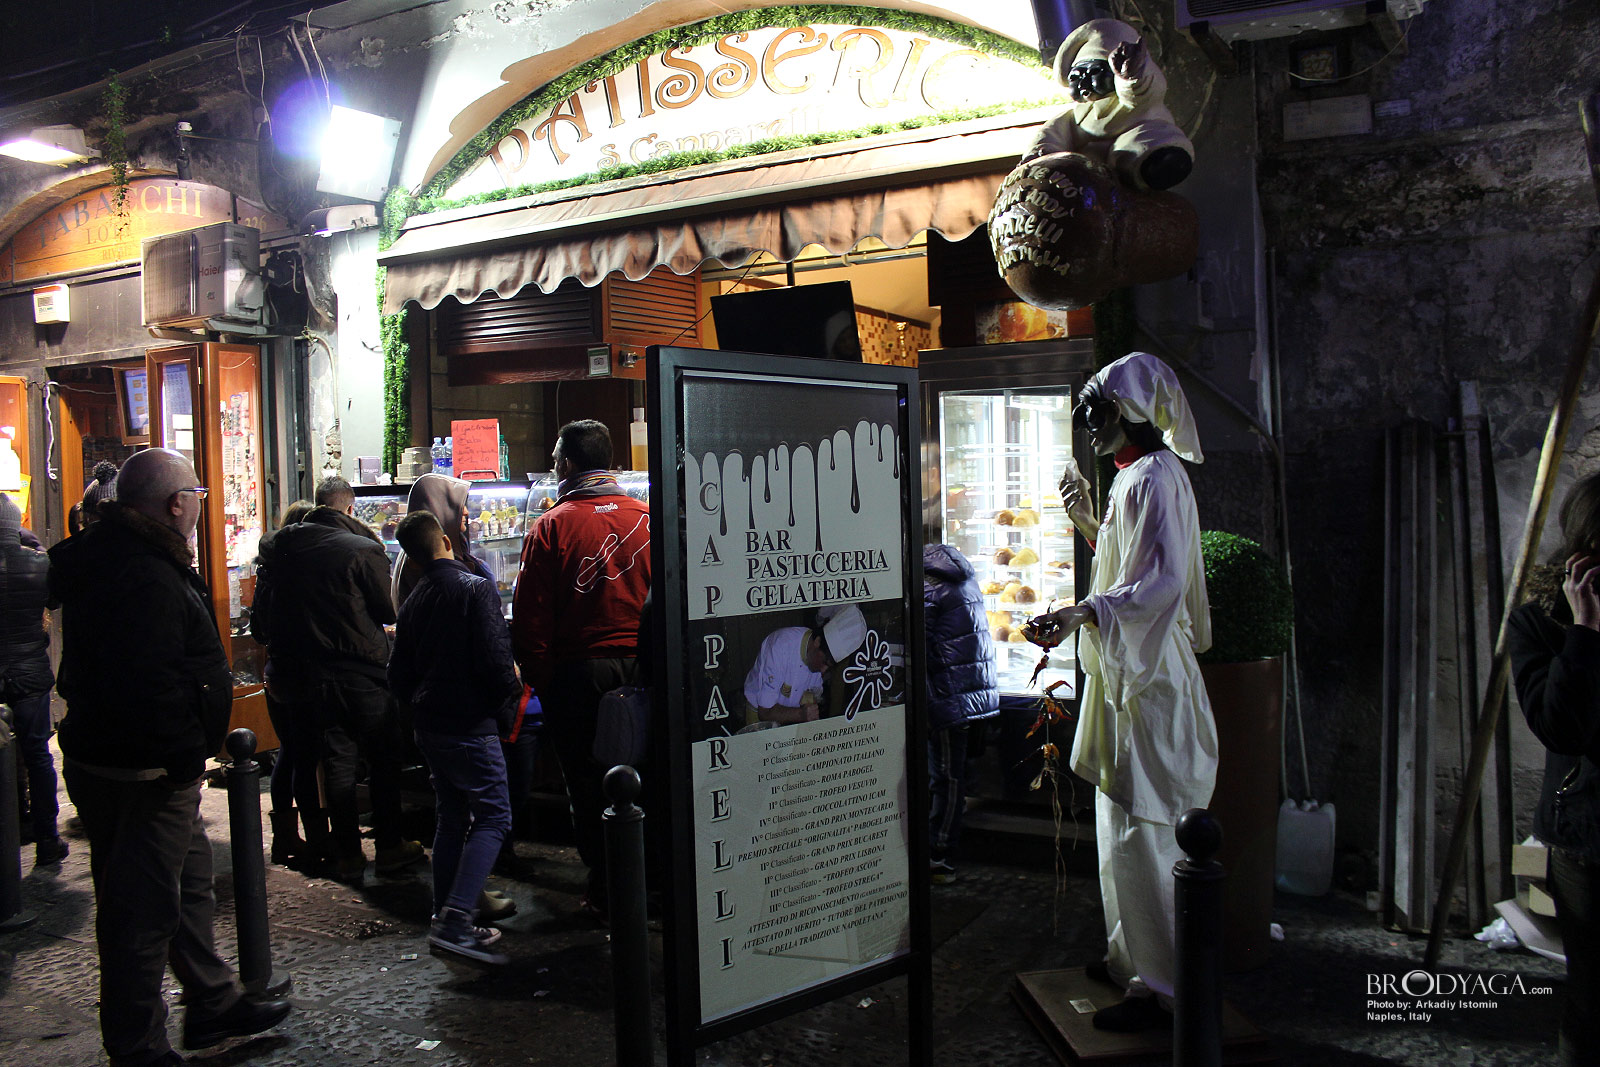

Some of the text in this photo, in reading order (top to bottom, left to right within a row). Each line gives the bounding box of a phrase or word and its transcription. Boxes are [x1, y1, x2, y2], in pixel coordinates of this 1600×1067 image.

[199, 264, 222, 278] Haier
[746, 528, 792, 553] BAR
[746, 548, 889, 584] PASTICCERIA
[746, 578, 872, 612] GELATERIA
[770, 753, 805, 765] Classificato
[811, 745, 835, 756] GRAND
[836, 742, 854, 752] PRIX
[854, 736, 879, 748] VIENNA
[772, 737, 808, 749] Classificato
[813, 730, 838, 742] GRAND
[838, 727, 855, 737] PRIX
[856, 722, 877, 733] EVIAN
[765, 768, 800, 781] Classificato
[806, 756, 852, 772] CAMPIONATO
[853, 748, 885, 762] ITALIANO
[779, 795, 813, 808] Classificato
[819, 786, 847, 798] TROFEO
[848, 778, 877, 790] VESUVIO
[782, 779, 816, 792] Classificato
[821, 773, 842, 783] ROMA
[764, 828, 799, 841] Classificato
[805, 819, 830, 830] GRAND
[831, 815, 848, 825] PRIX
[848, 802, 894, 820] MONTECARLO
[772, 811, 807, 824] Classificato
[812, 792, 868, 814] CIOCCOLATTINO
[869, 790, 886, 800] ICAM
[738, 849, 767, 862] PREMIO
[768, 838, 802, 854] SPECIALE
[770, 854, 805, 868] Classificato
[811, 846, 836, 857] GRAND
[836, 840, 854, 850] PRIX
[854, 830, 888, 846] BUCAREST
[774, 868, 809, 882] Classificato
[814, 858, 839, 870] GRAND
[840, 853, 856, 864] PRIX
[857, 845, 886, 859] LISBONA
[782, 895, 817, 909] Classificato
[783, 880, 817, 894] Classificato
[742, 930, 784, 950] ATTESTATO
[793, 919, 821, 933] MERITO
[828, 908, 853, 922] TUTORE
[854, 903, 868, 914] DEL
[868, 890, 908, 910] PATRIMONIO
[747, 914, 789, 934] ATTESTATO
[799, 893, 860, 917] RICONOSCIMENTO
[775, 940, 798, 953] DELLA
[799, 926, 841, 946] TRADIZIONE
